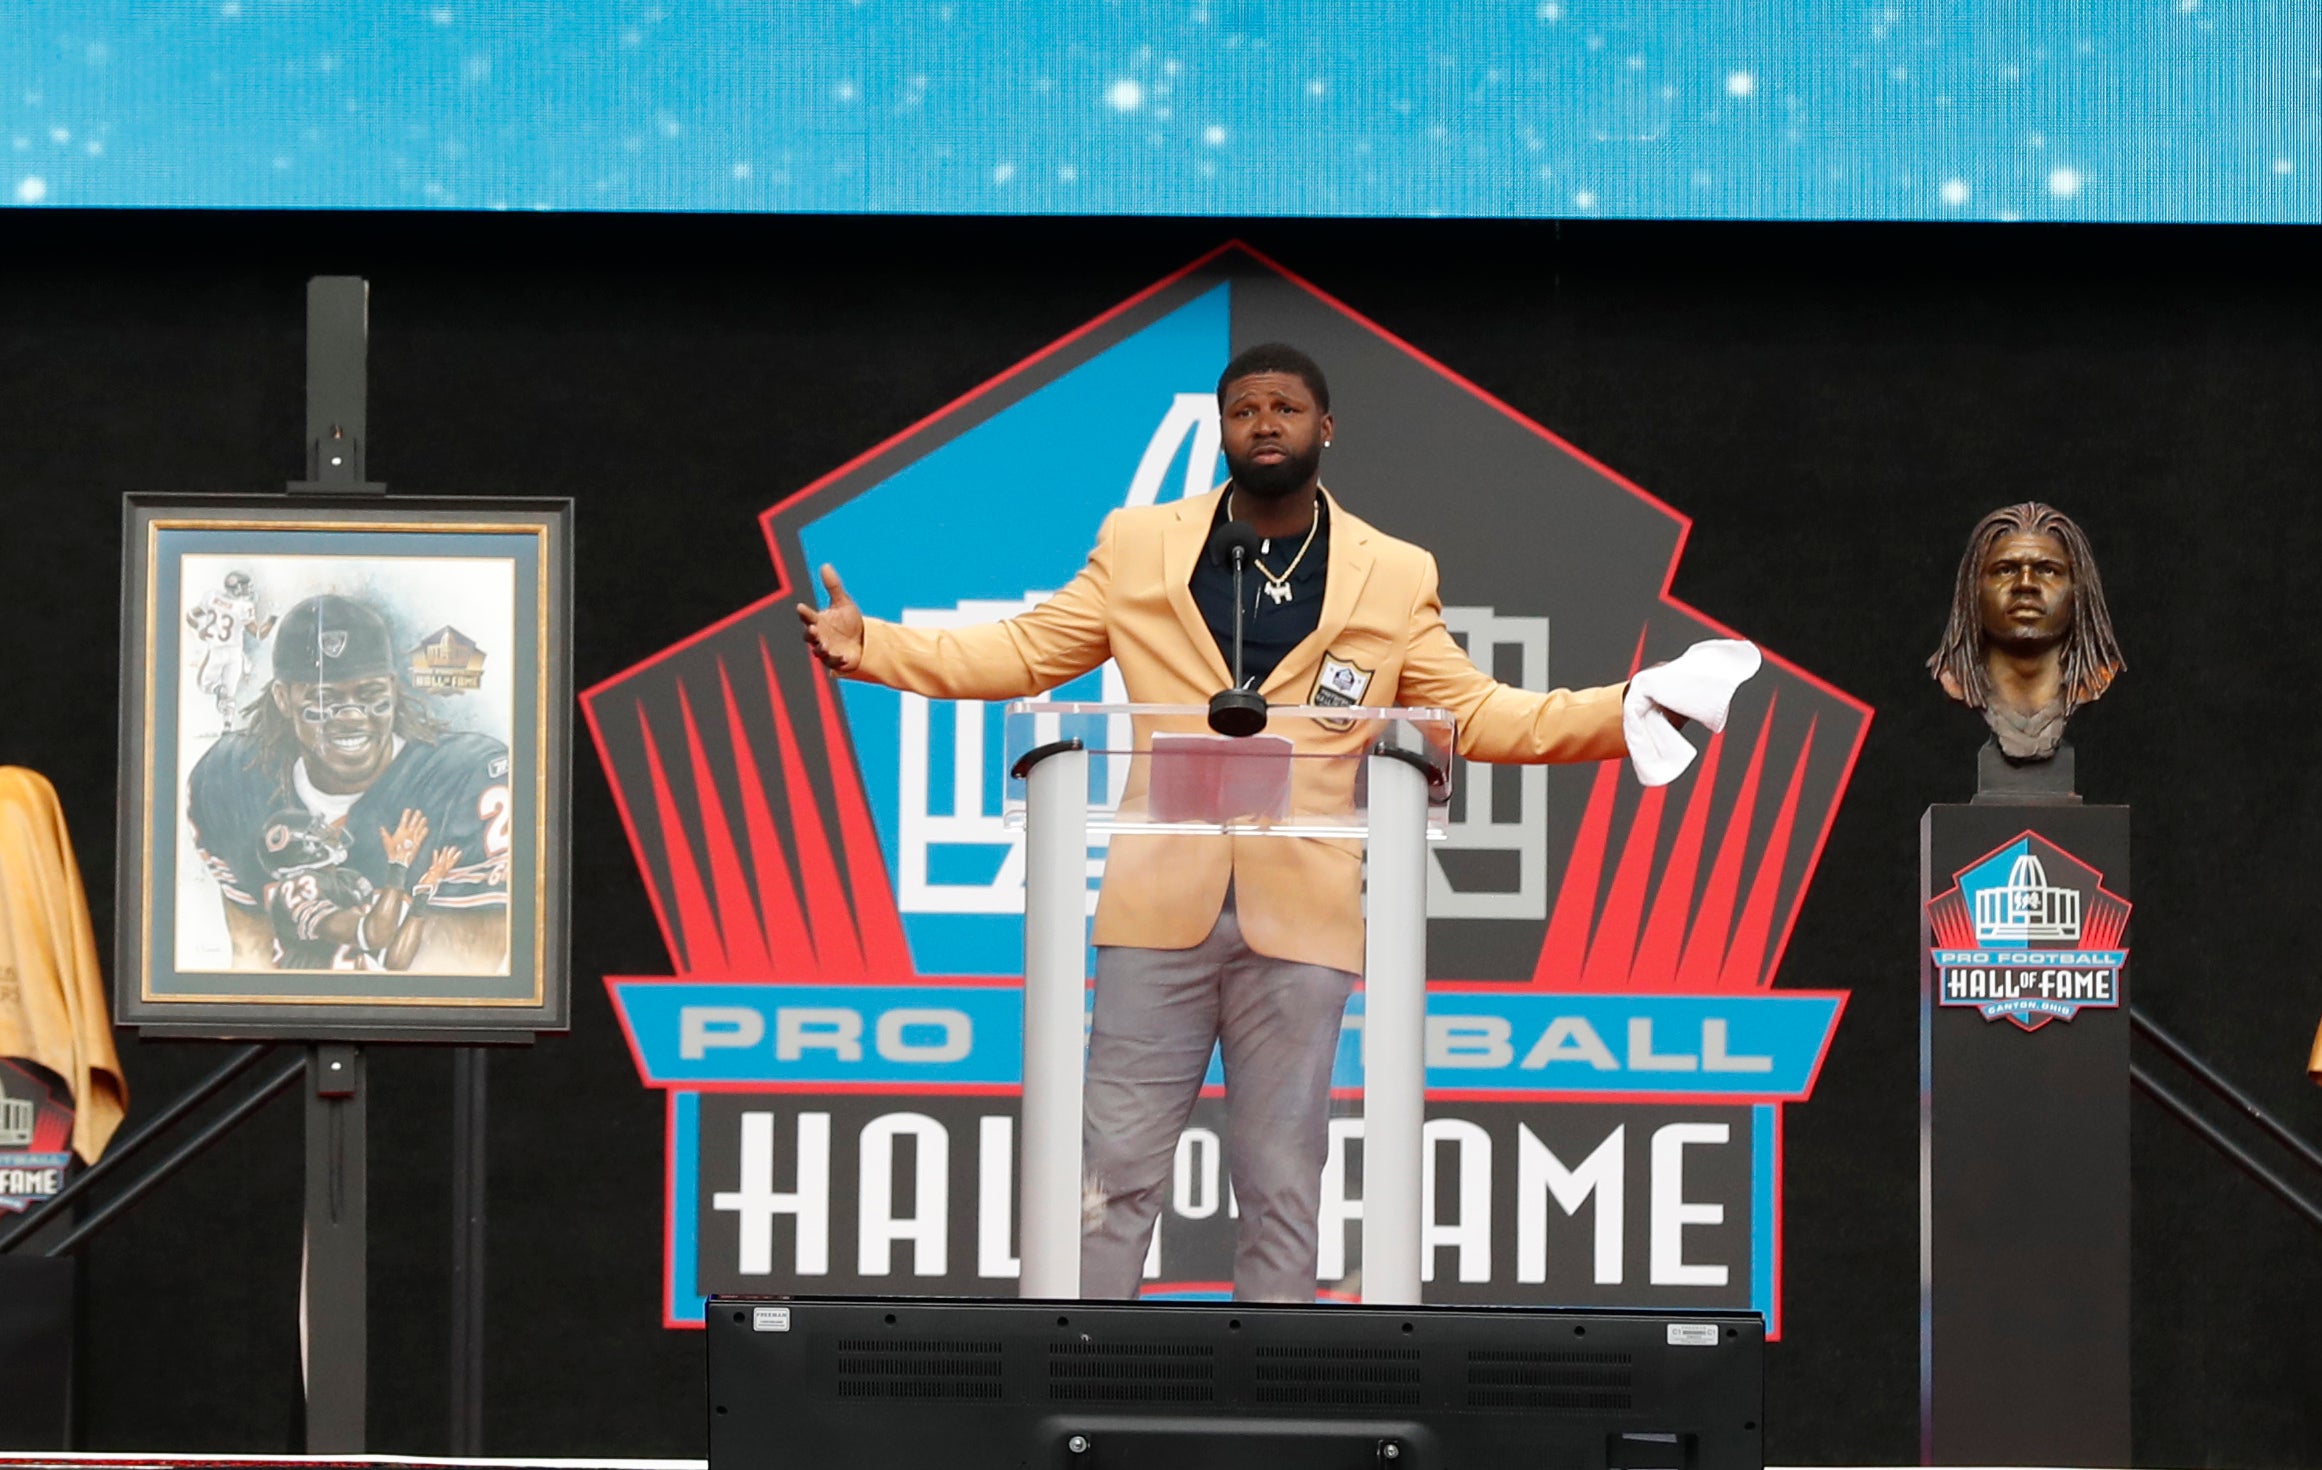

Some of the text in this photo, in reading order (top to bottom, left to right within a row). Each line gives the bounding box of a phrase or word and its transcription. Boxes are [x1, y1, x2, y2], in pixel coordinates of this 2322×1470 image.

[198, 608, 234, 641] 23
[279, 874, 319, 910] 23
[1942, 953, 2117, 965] PRO FOOTBALL
[1948, 969, 2110, 999] HALL OF FAME
[2040, 1002, 2070, 1015] OHIO
[680, 1006, 974, 1063] PRO
[0, 1169, 57, 1194] FAME
[714, 1111, 1162, 1279] HAL
